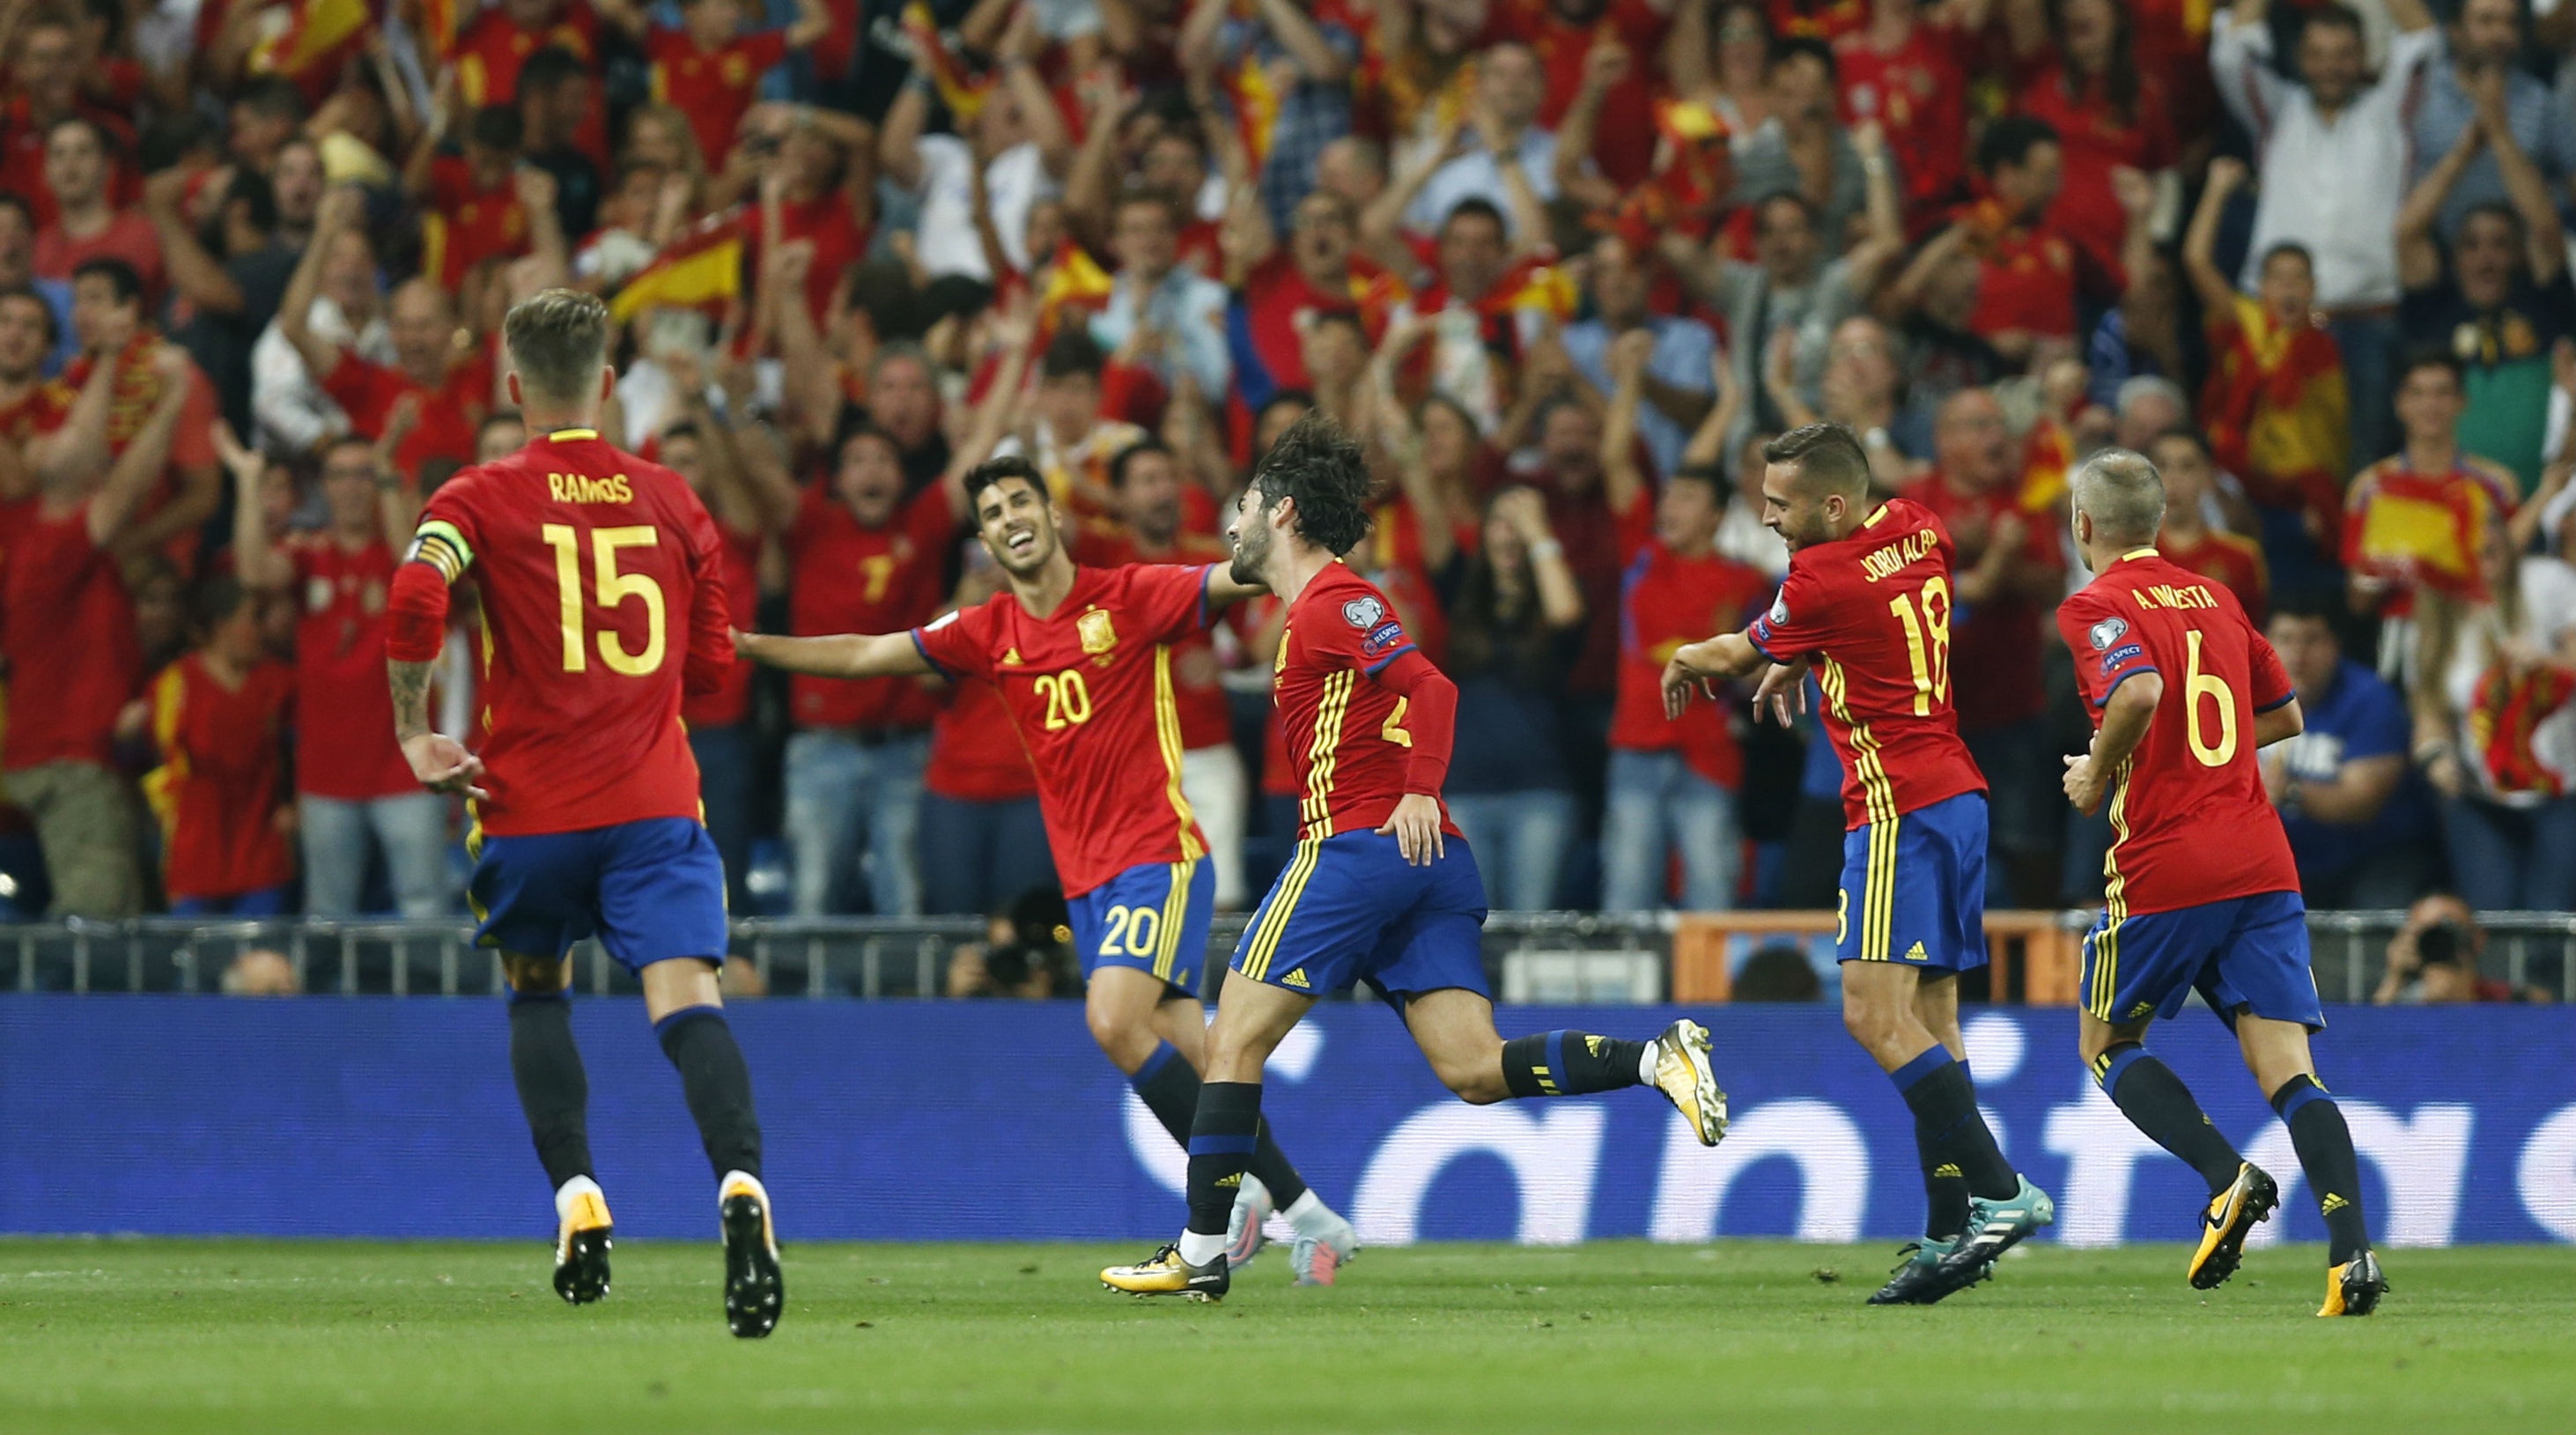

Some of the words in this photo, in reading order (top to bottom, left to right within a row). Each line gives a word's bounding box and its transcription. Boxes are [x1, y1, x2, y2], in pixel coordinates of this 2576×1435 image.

[548, 472, 634, 504] RAMOS
[542, 523, 666, 676] 15
[1860, 543, 1906, 583] JORDI
[1889, 576, 1950, 716] 18
[1033, 669, 1092, 731] 20
[2186, 630, 2237, 766] 6
[1098, 905, 1160, 958] 20
[1123, 1002, 2576, 1246] anita
